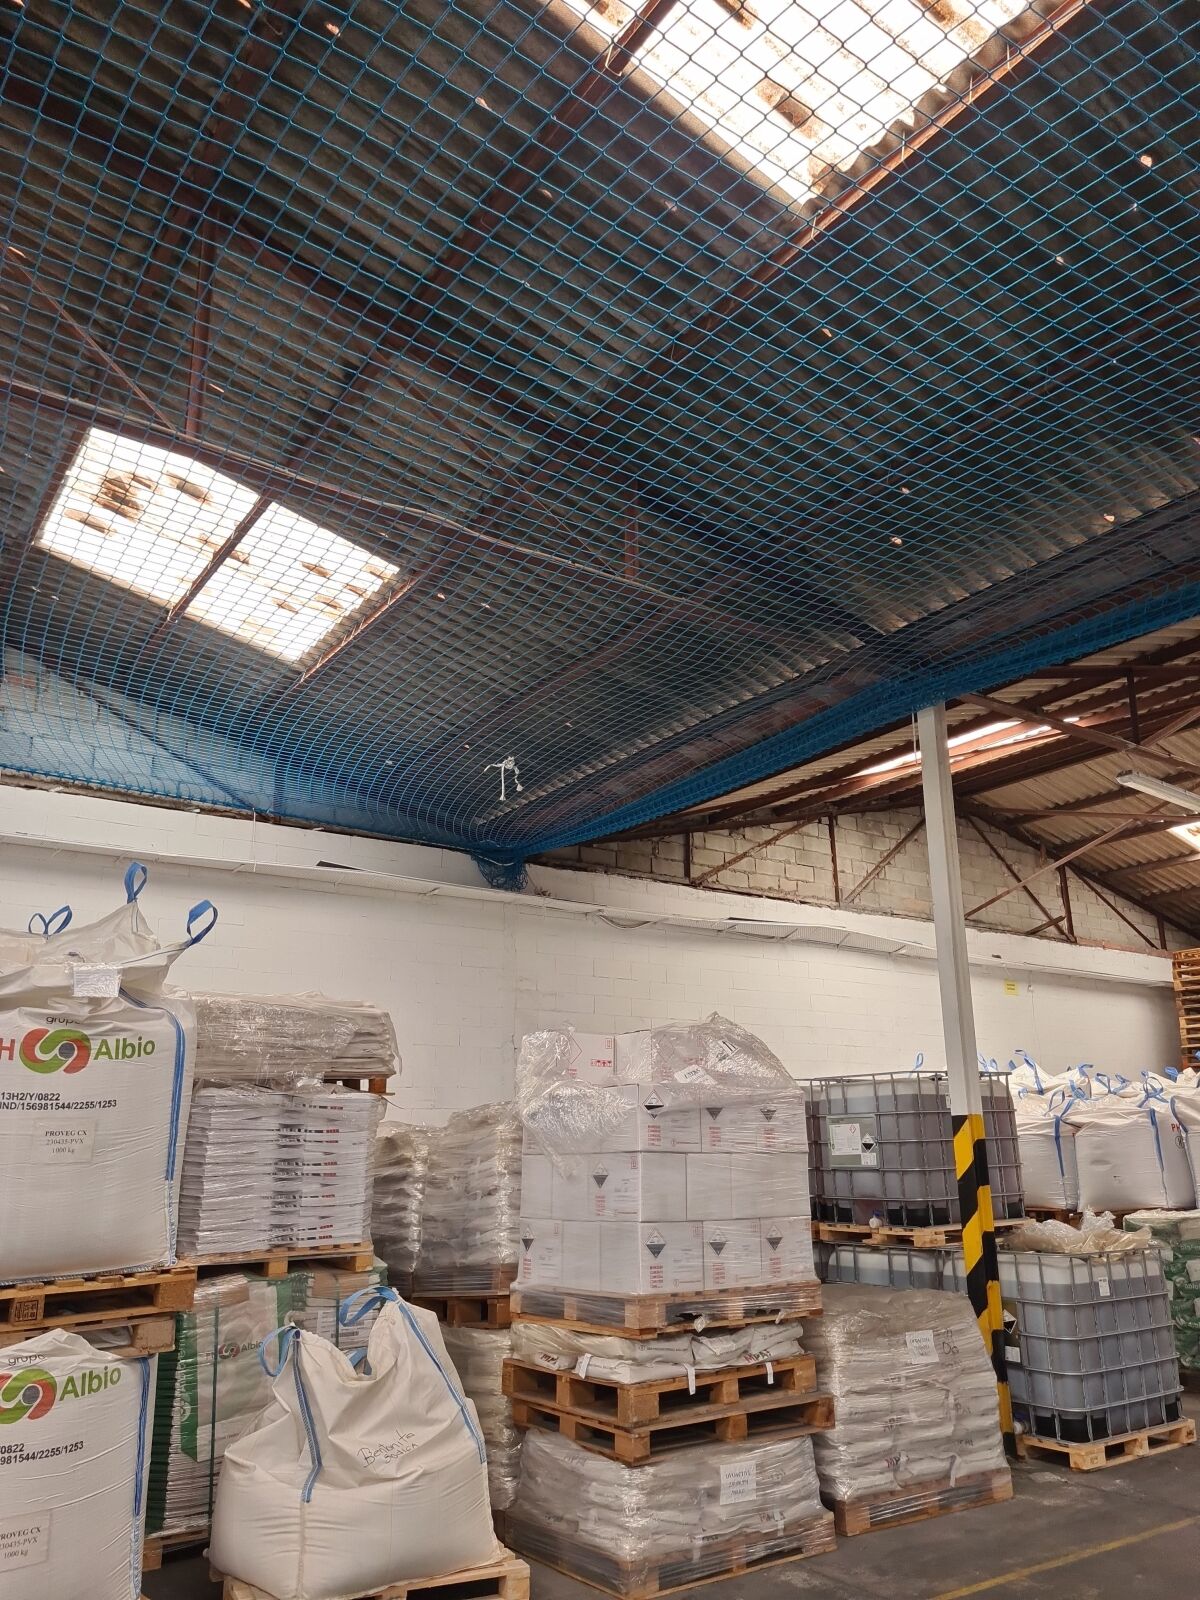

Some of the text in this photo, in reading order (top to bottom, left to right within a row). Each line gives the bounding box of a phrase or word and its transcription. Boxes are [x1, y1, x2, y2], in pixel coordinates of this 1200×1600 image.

[94, 1036, 155, 1061] Albio
[1, 1092, 60, 1101] 13H2/Y/0822
[59, 1365, 122, 1401] Albio
[0, 1529, 29, 1540] ROVEG
